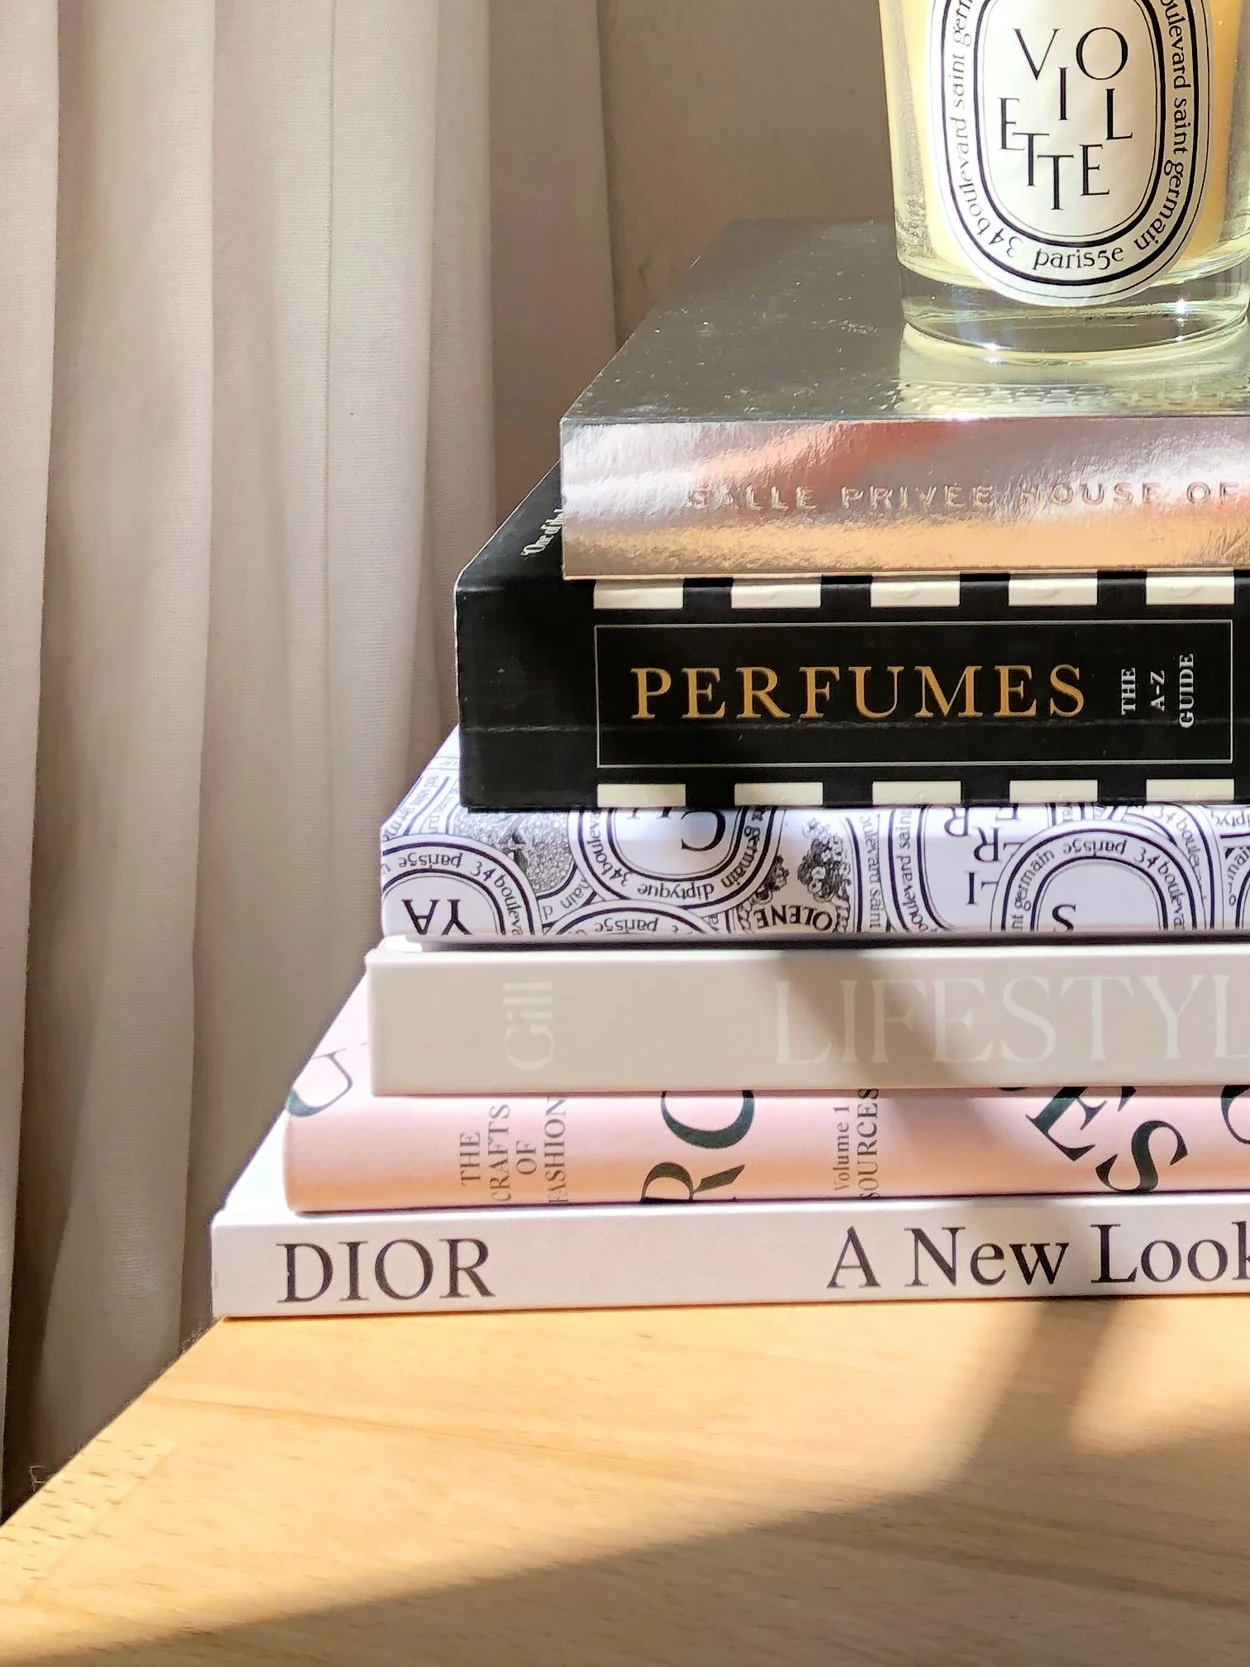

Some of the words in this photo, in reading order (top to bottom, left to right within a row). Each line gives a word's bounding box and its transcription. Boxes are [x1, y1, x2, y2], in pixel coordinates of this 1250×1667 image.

[948, 53, 965, 110] saint
[1173, 97, 1191, 154] saint
[950, 116, 991, 236] boulevard
[1133, 159, 1184, 251] germain
[687, 484, 818, 511] SALLE
[1019, 480, 1163, 507] HOUSE
[1185, 480, 1240, 505] OF
[630, 663, 1086, 720] PERFUMES
[1120, 667, 1137, 716] THE
[1149, 669, 1166, 712] A-Z
[1178, 653, 1195, 729] GUIDE
[637, 882, 715, 901] diptyque
[503, 980, 555, 1072] Gill
[834, 1104, 851, 1114] 1
[459, 1130, 481, 1187] THE
[487, 1102, 511, 1204] CRAFTS
[515, 1139, 538, 1176] OF
[544, 1095, 570, 1206] FASHION
[833, 1120, 851, 1192] Volume
[856, 1087, 880, 1200] SOURCES
[275, 1237, 497, 1305] DIOR
[826, 1224, 882, 1290] A
[903, 1224, 1070, 1288] New
